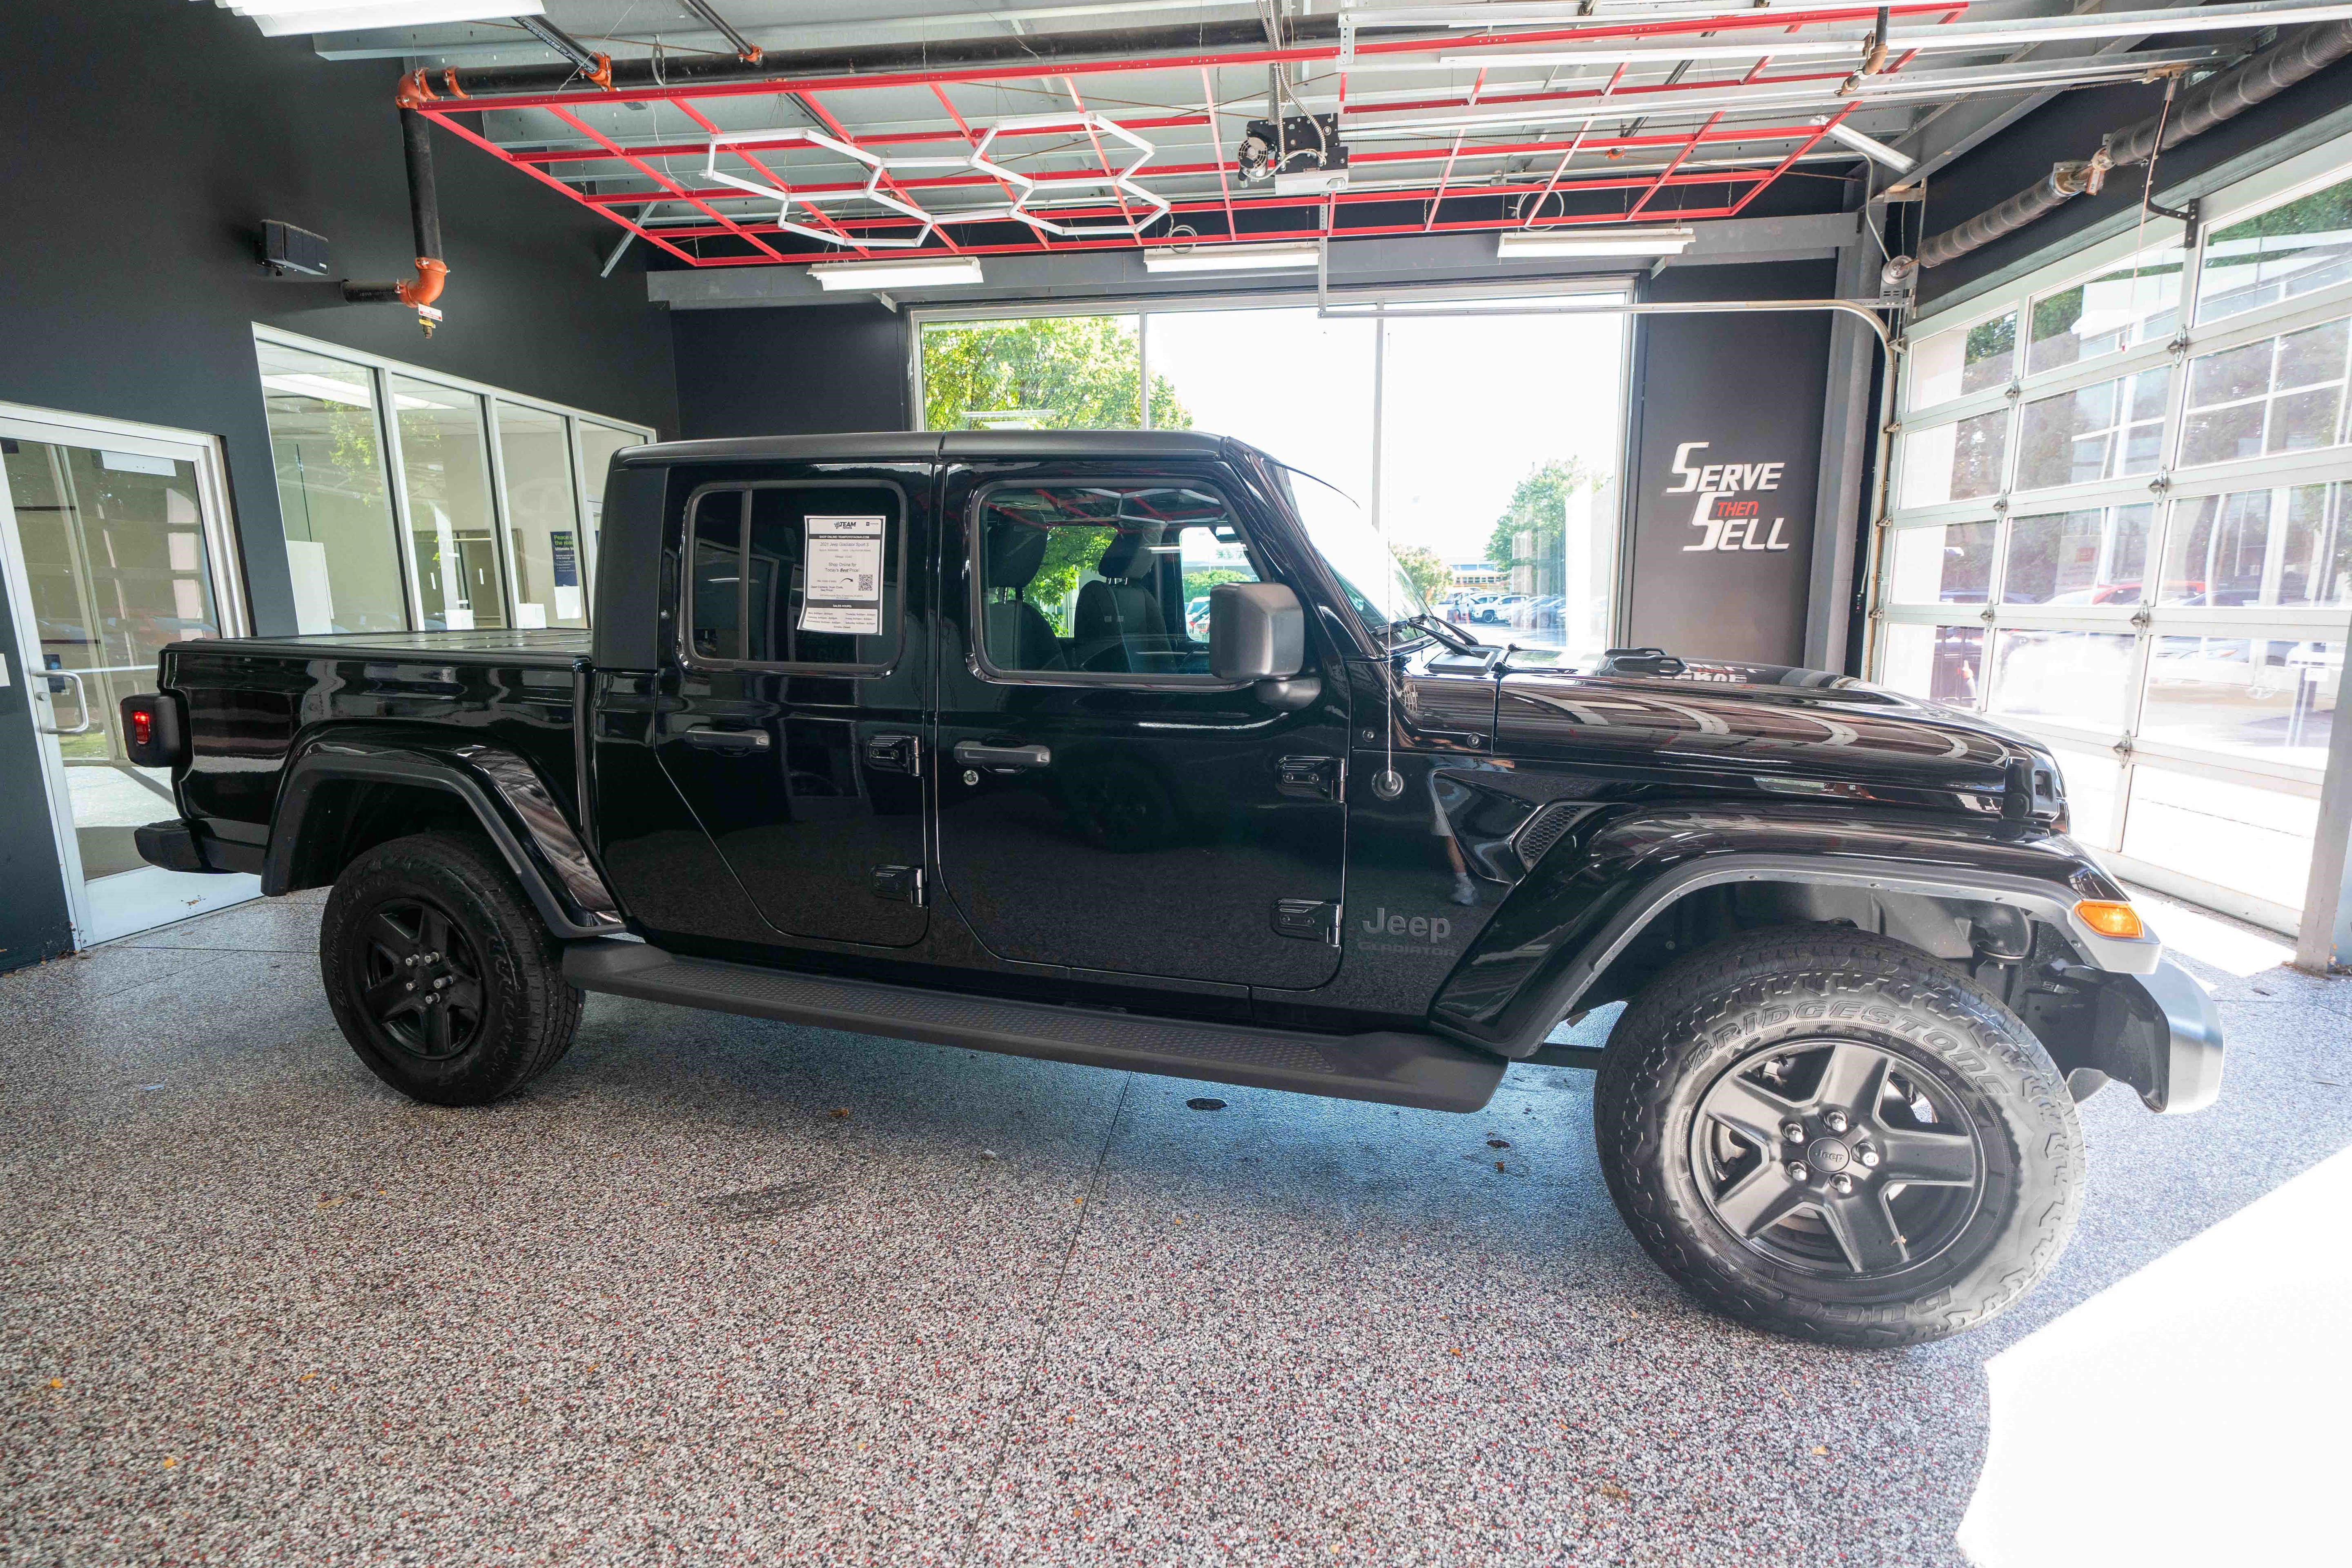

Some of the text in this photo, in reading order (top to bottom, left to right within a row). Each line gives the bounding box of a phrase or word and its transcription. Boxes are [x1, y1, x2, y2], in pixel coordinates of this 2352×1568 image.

[1666, 442, 1785, 492] SERVE
[1683, 491, 1789, 551] SELL
[1717, 501, 1759, 517] THEN
[1362, 907, 1450, 943] Jeep
[1358, 941, 1459, 957] GLADIATOR
[1686, 1000, 2010, 1096] BRIDGESTONE
[1813, 1148, 1844, 1163] Jeep
